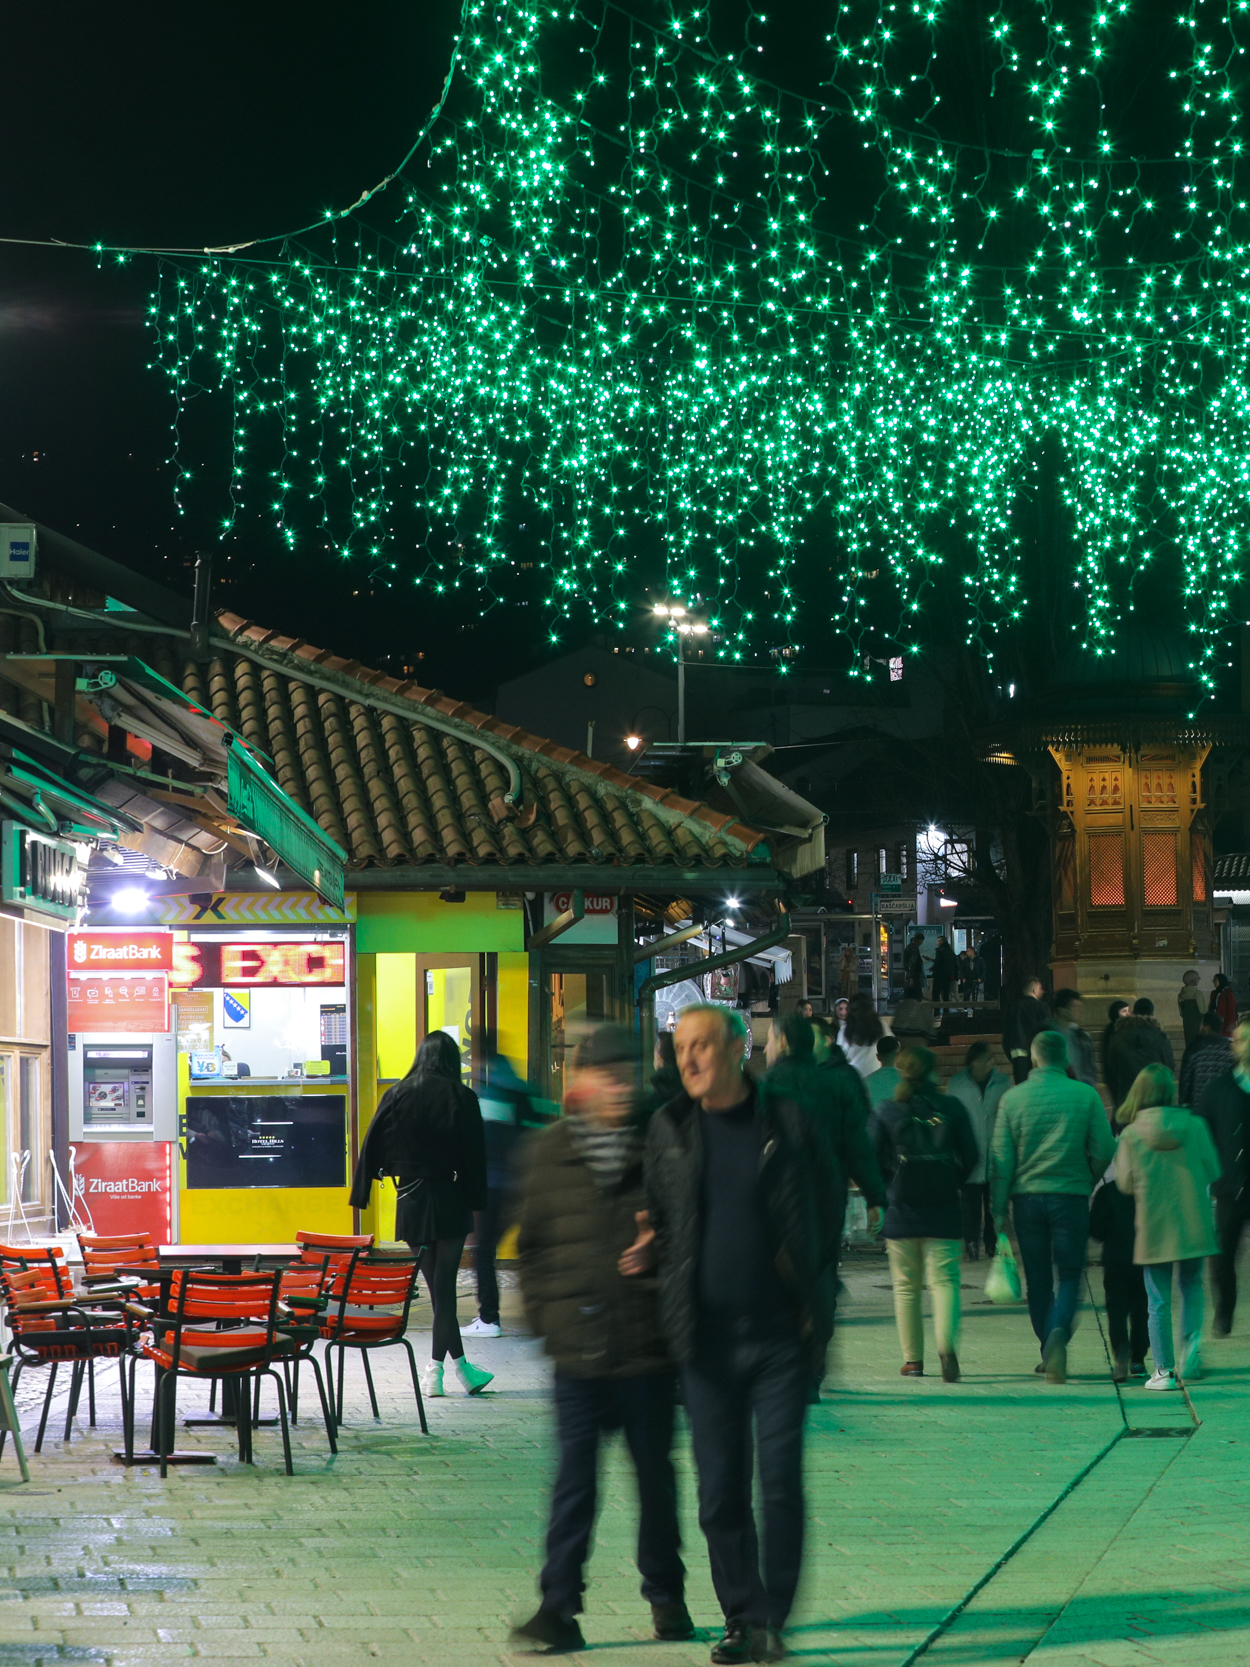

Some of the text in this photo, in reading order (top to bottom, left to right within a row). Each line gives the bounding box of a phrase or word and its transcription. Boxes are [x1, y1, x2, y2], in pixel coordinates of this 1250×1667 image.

[10, 548, 30, 556] Haier
[558, 896, 611, 912] ÇKUR
[881, 902, 915, 910] BAŠČARŠIJA
[90, 944, 162, 959] ZiraatBank
[89, 1178, 163, 1193] ZiraatBank
